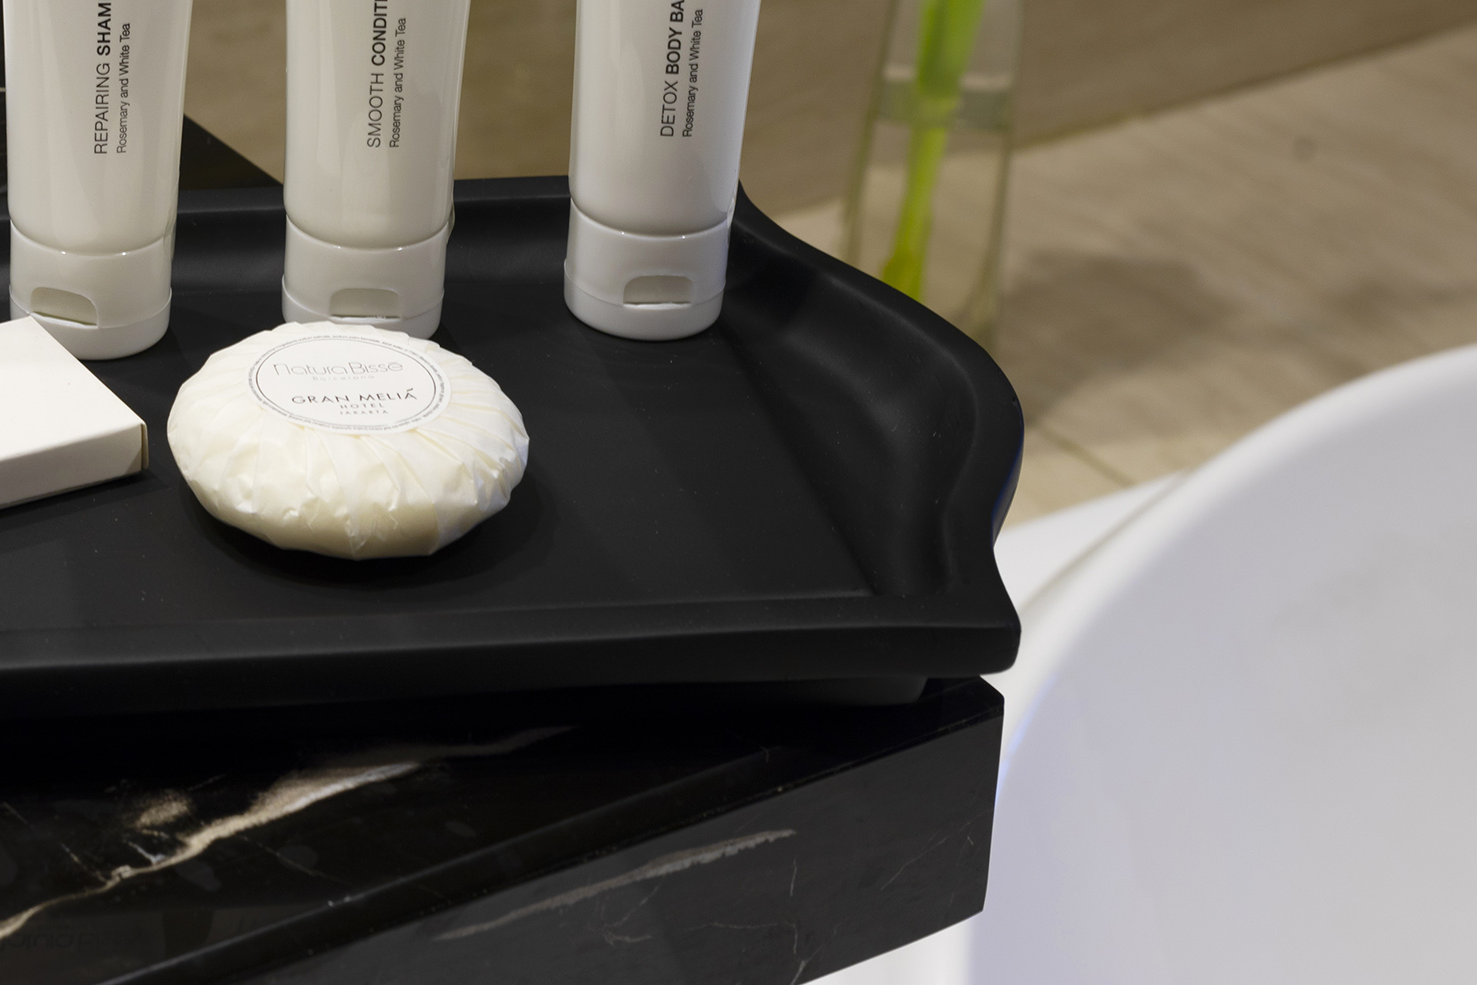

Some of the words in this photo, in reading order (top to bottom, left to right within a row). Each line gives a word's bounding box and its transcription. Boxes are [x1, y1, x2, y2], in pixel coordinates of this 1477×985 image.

[119, 23, 130, 42] Tea
[394, 18, 406, 37] Tea
[691, 9, 703, 28] Tea
[118, 45, 130, 76] White
[393, 39, 405, 70] White
[665, 27, 682, 75] BODY
[689, 31, 701, 61] White
[118, 78, 129, 98] and
[393, 73, 403, 93] and
[688, 63, 699, 83] and
[94, 63, 110, 154] REPAIRING
[367, 73, 384, 148] SMOOTH
[389, 96, 404, 148] Rosemary
[660, 81, 678, 137] DETOX
[682, 86, 698, 137] Rosemary
[116, 101, 130, 153] Rosemary
[273, 362, 349, 376] Natura
[291, 395, 350, 404] GRAN
[359, 388, 418, 402] MELIÁ
